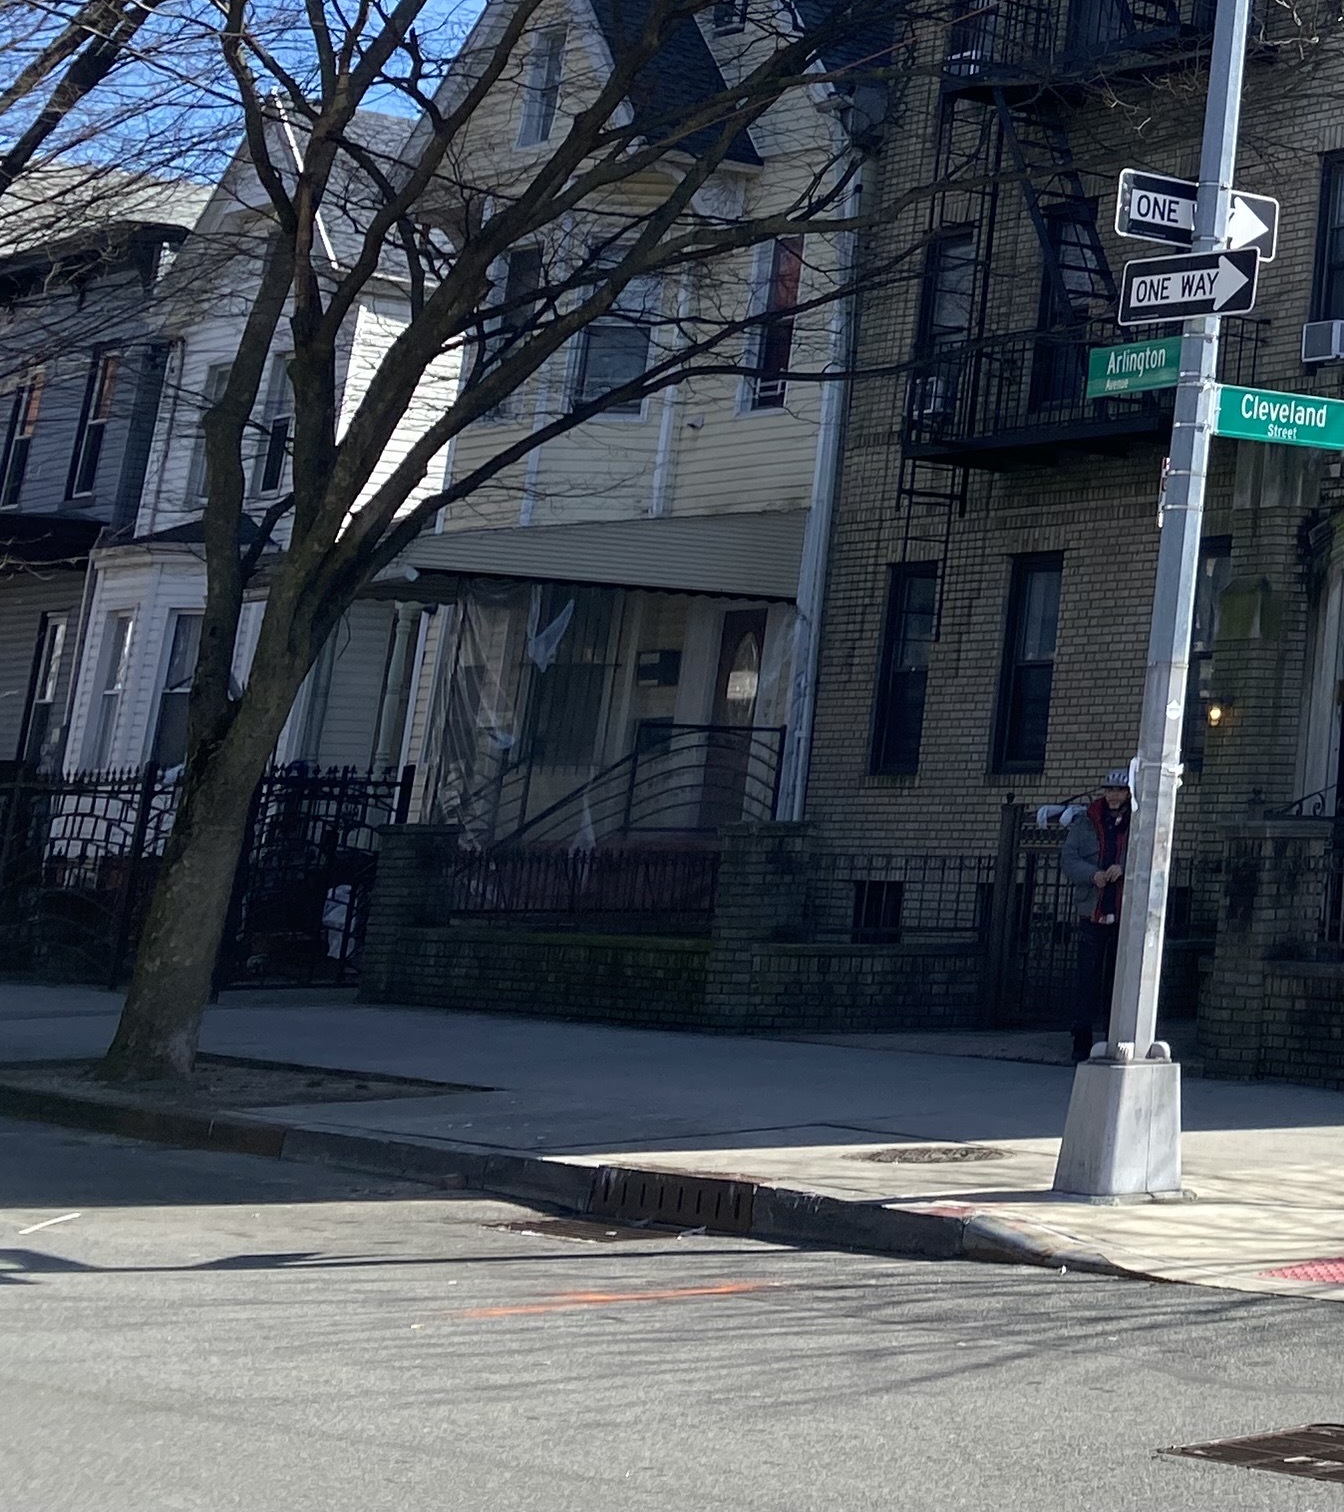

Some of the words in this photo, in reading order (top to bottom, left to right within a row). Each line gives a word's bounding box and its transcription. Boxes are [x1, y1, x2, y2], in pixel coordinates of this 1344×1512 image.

[1137, 194, 1180, 223] ONE
[1136, 277, 1171, 303] ONE
[1181, 271, 1219, 298] WAY
[1106, 347, 1166, 377] Arlington
[1105, 377, 1129, 391] Avenue
[1241, 394, 1328, 428] Cleveland
[1267, 424, 1297, 440] Street
